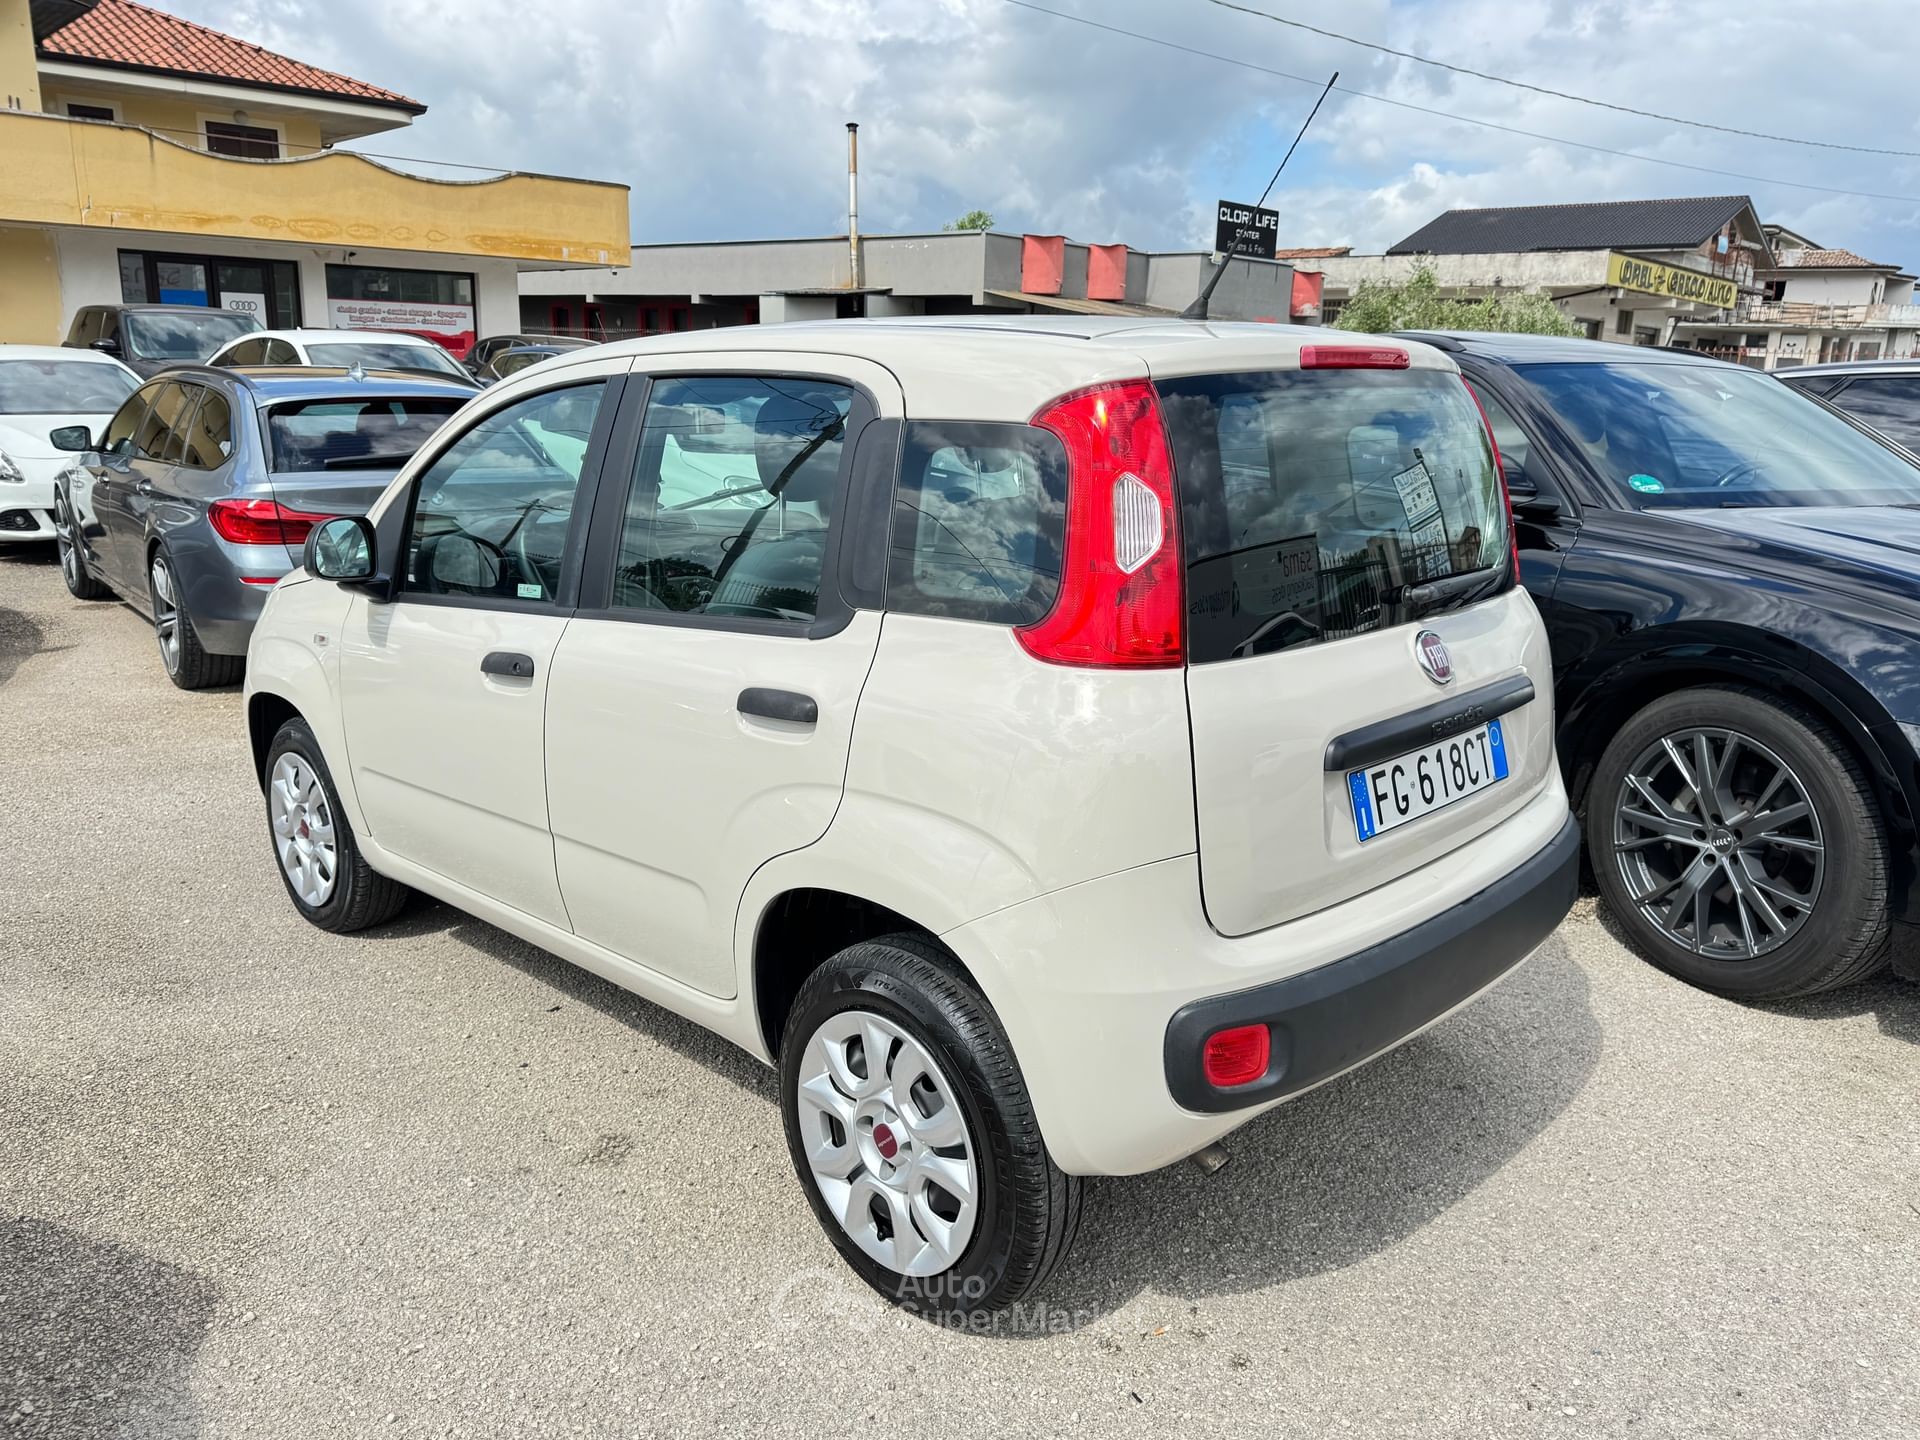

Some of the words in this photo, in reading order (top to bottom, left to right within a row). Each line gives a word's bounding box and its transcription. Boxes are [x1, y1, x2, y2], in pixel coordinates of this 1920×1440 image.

[1256, 213, 1278, 230] LIFE
[1619, 259, 1653, 289] OPEL
[1425, 644, 1448, 670] FIAT
[1431, 705, 1486, 741] panda
[1371, 764, 1410, 826] FG
[1417, 731, 1490, 805] 618CT
